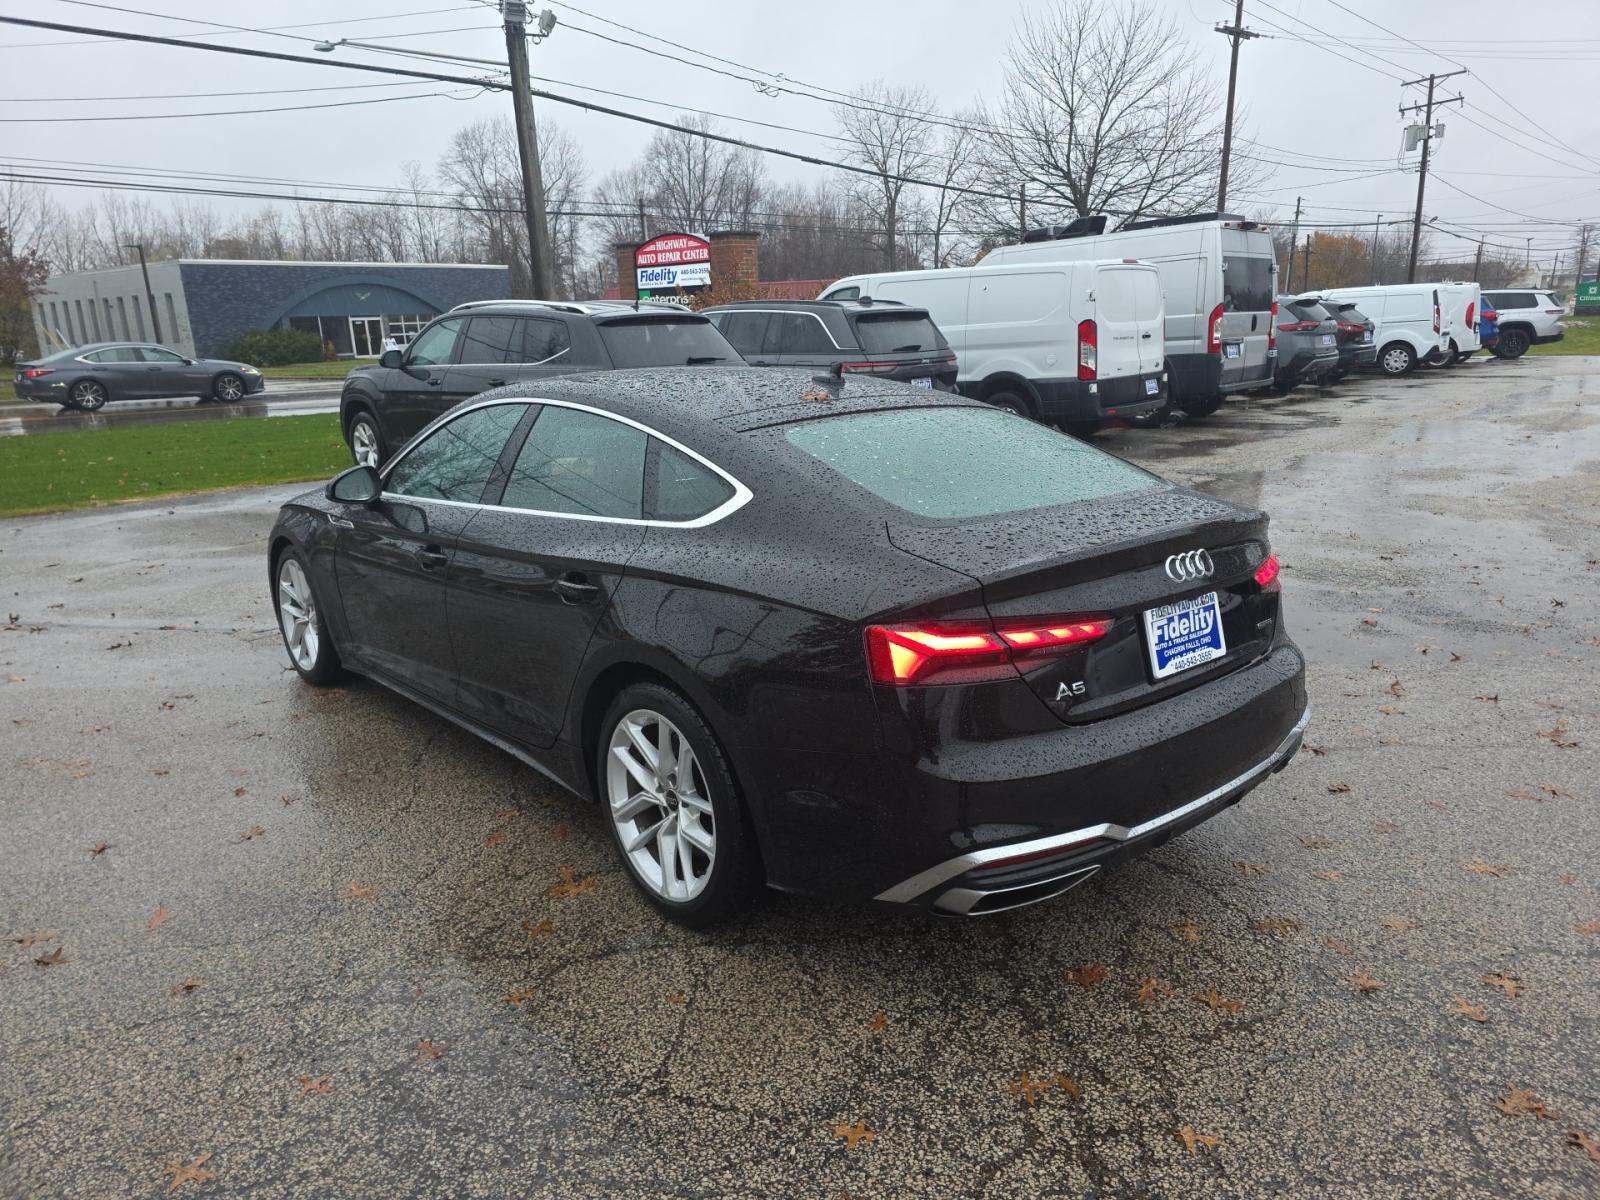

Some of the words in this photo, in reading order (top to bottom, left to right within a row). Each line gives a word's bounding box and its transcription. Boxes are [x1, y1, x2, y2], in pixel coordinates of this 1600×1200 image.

[656, 239, 687, 250] HIGHWAY
[638, 253, 656, 265] AUTO
[657, 251, 681, 263] REPAIR
[682, 248, 709, 260] CENTER
[640, 268, 677, 284] Fidelity
[1152, 608, 1214, 645] Fidelity
[1155, 642, 1168, 651] AUTO
[1173, 635, 1189, 645] TRUCK
[1189, 630, 1204, 640] SALES
[1164, 645, 1184, 657] CHAGRIN
[1201, 635, 1212, 645] OHIO
[1056, 680, 1086, 701] A5
